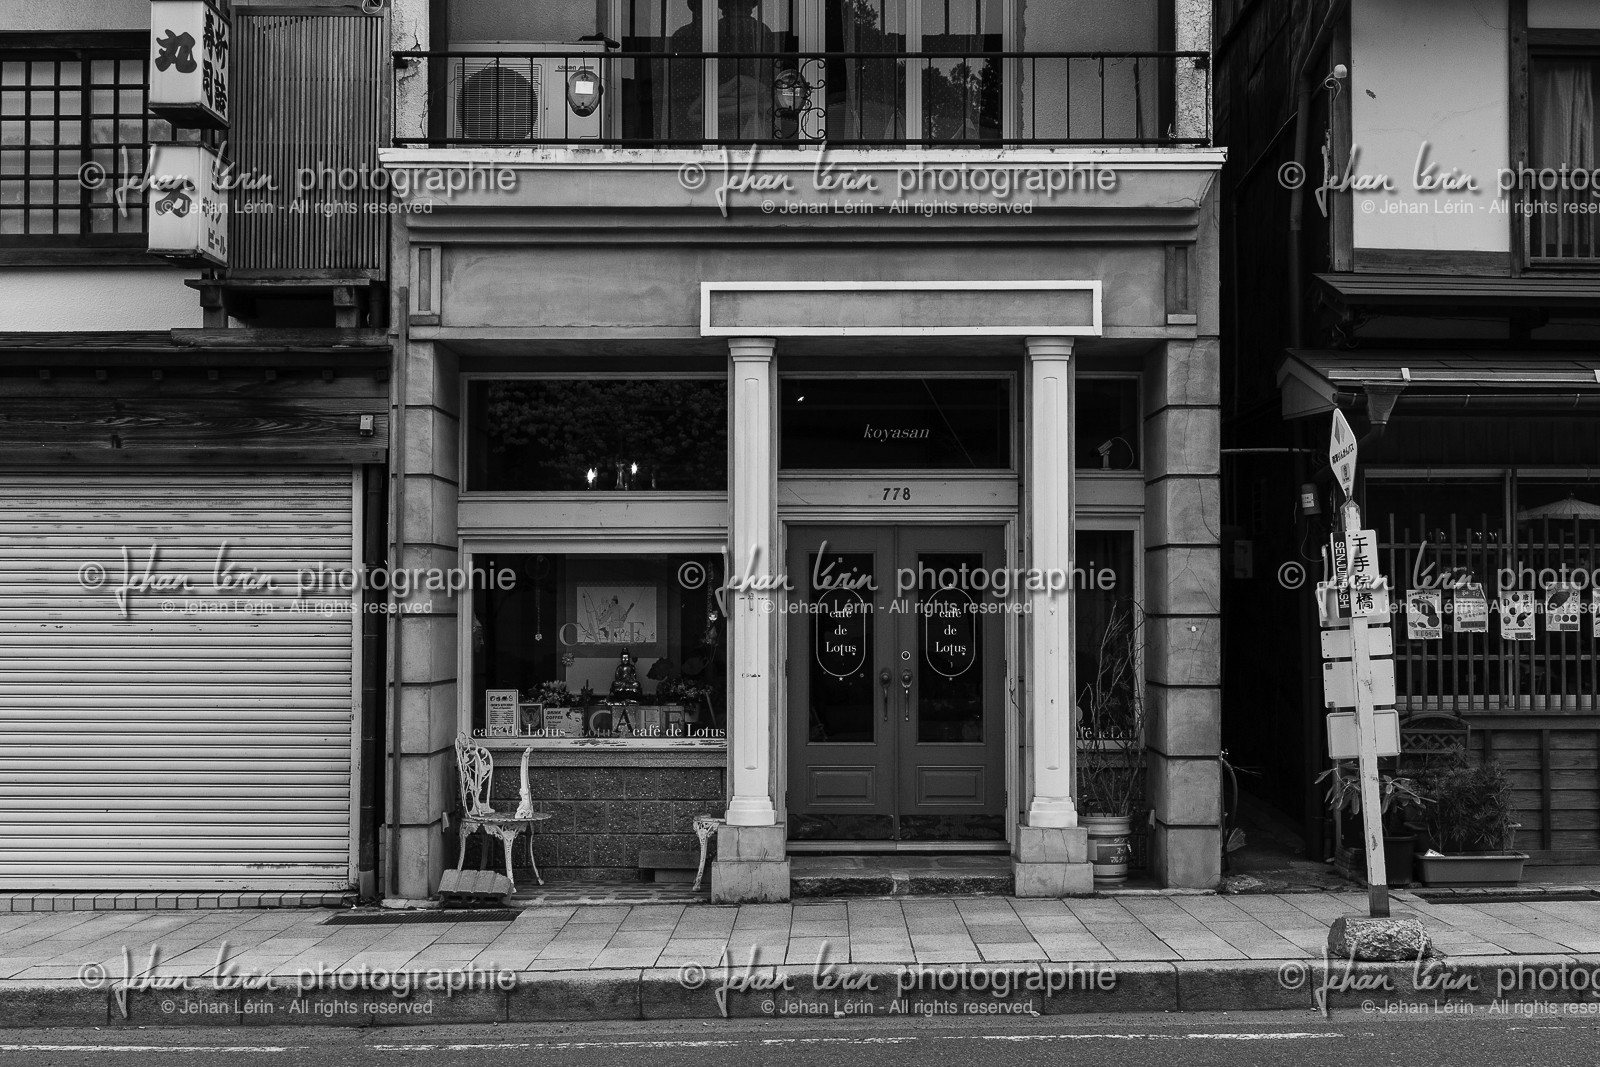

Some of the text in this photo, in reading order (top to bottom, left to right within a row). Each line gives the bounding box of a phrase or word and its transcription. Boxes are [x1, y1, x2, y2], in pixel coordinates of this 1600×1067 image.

[155, 29, 197, 73] 丸
[208, 228, 226, 255] ビール
[863, 424, 930, 442] koyasan
[882, 487, 911, 500] 778
[1352, 536, 1373, 611] 千手院橋
[829, 608, 852, 618] café
[939, 608, 962, 618] café
[834, 625, 847, 636] de
[943, 625, 957, 636] de
[826, 642, 857, 656] Lotus
[935, 642, 967, 656] Lotus
[526, 723, 566, 738] Lotus
[632, 723, 726, 738] café de Lotus
